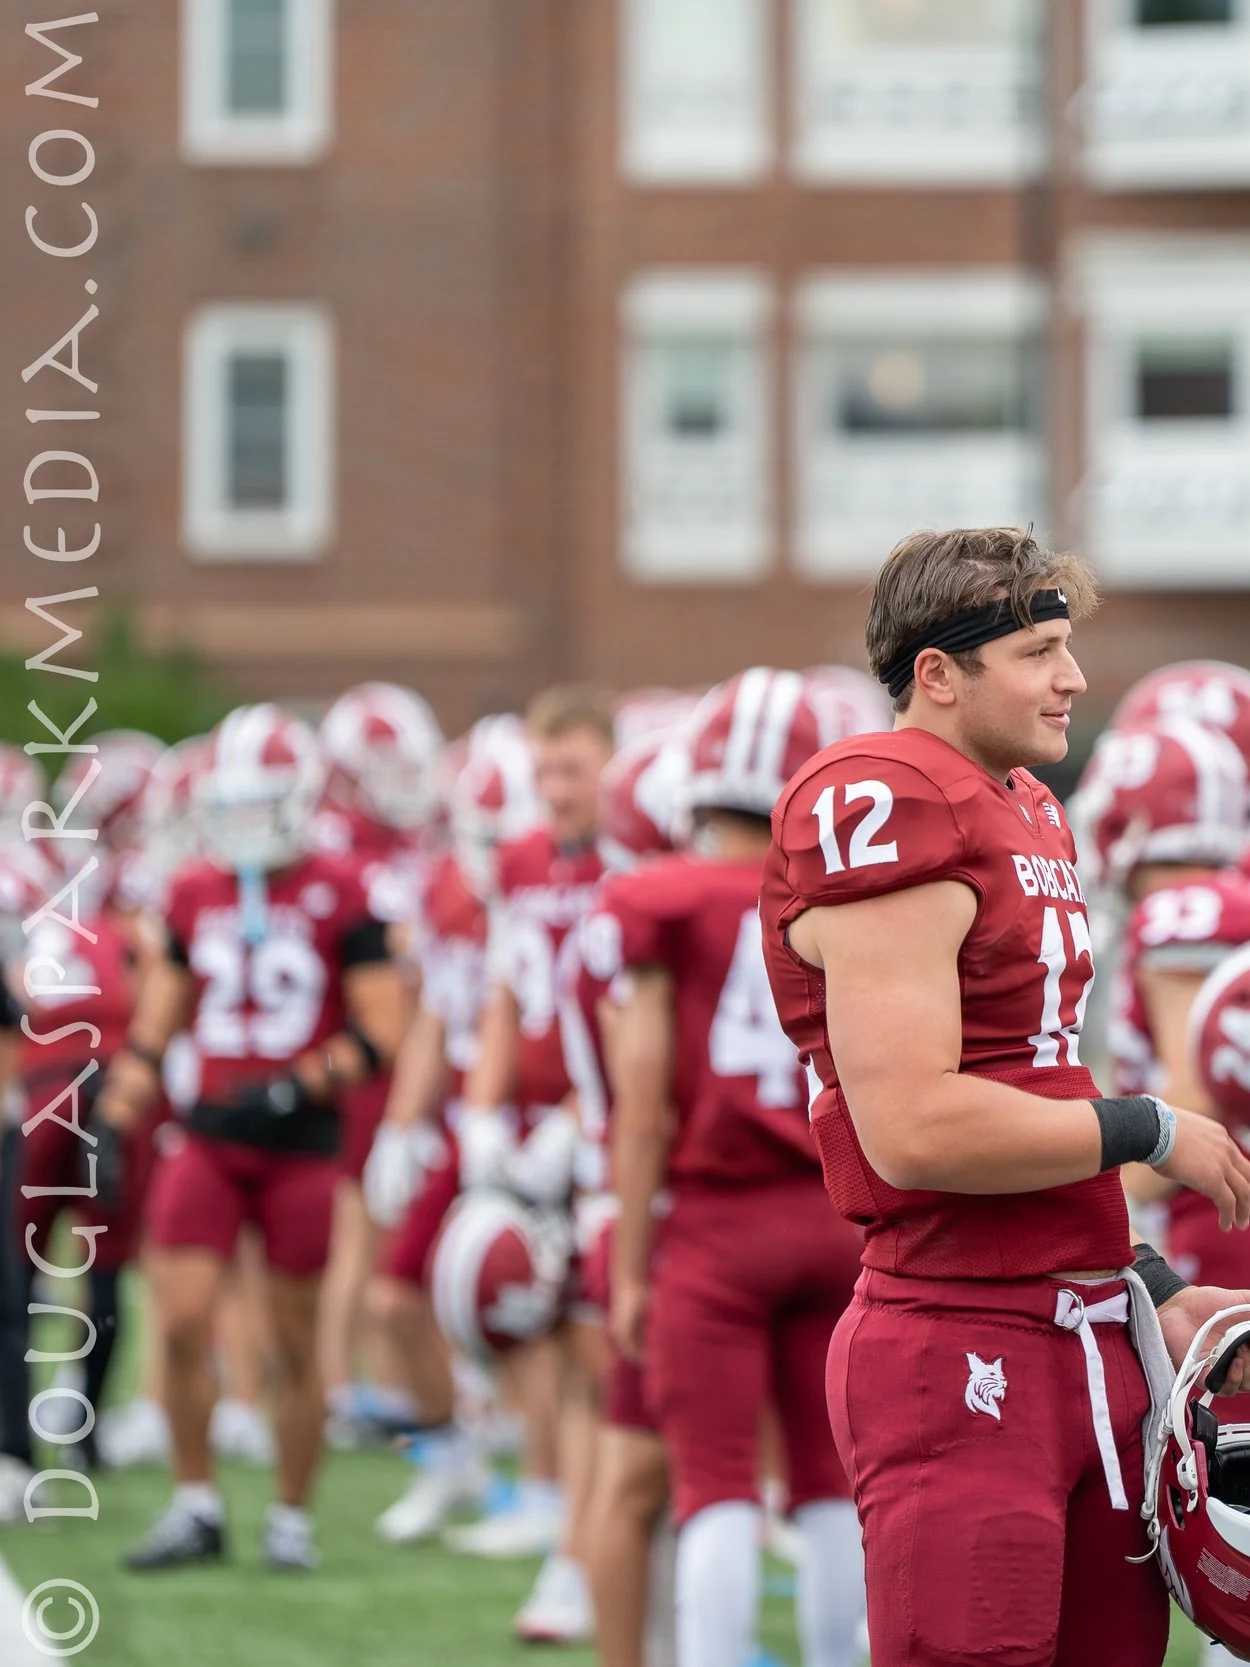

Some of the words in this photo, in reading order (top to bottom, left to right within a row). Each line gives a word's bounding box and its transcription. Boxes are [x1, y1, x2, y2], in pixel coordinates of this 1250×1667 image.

[810, 779, 898, 876] 12
[1011, 854, 1088, 906] BOBCAT
[189, 935, 330, 1060] 29
